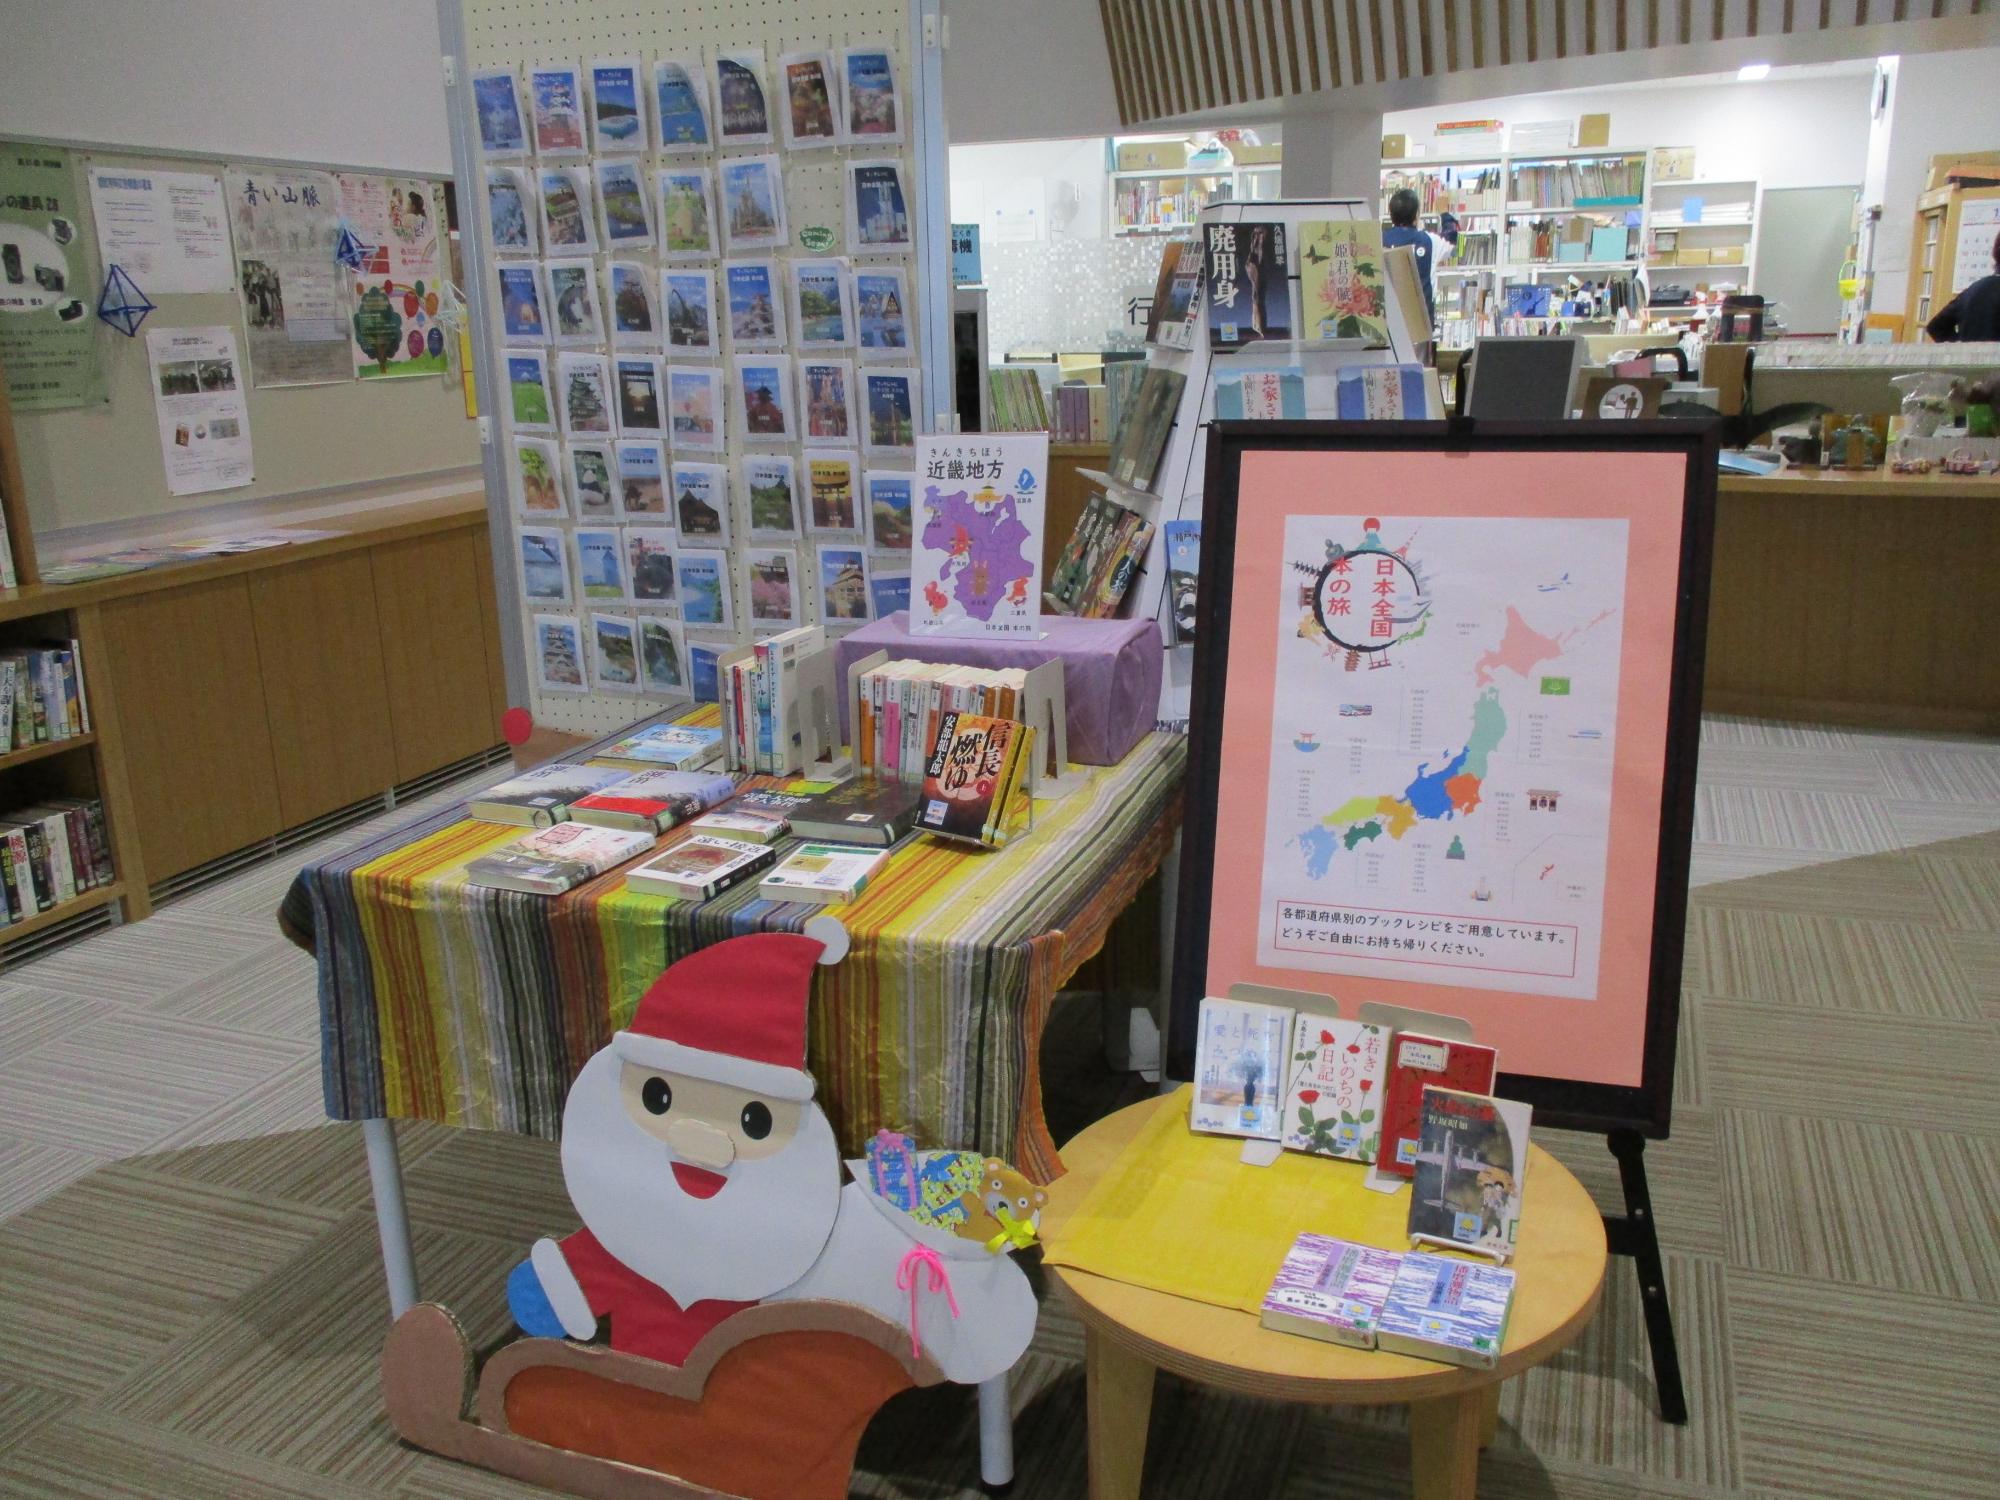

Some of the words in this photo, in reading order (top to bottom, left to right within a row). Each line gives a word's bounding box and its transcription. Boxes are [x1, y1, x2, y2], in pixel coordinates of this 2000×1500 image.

[243, 179, 321, 208] 青い山脈
[1209, 225, 1239, 309] 廃用身
[927, 460, 1004, 480] 近畿地方
[930, 446, 1004, 457] きんきちぼう
[1327, 557, 1352, 616] 本の旅
[1370, 559, 1396, 637] 日本全国
[945, 732, 982, 790] 燃ゆ
[974, 722, 1011, 778] 信長
[1281, 927, 1485, 958] どうぞご自由にお持ち帰りください。
[1282, 907, 1565, 945] 各都道府県別のブックレシピをご用意しています。
[1317, 1049, 1335, 1083] 日記
[1364, 1037, 1381, 1073] 若き
[1336, 1052, 1356, 1109] いのちの
